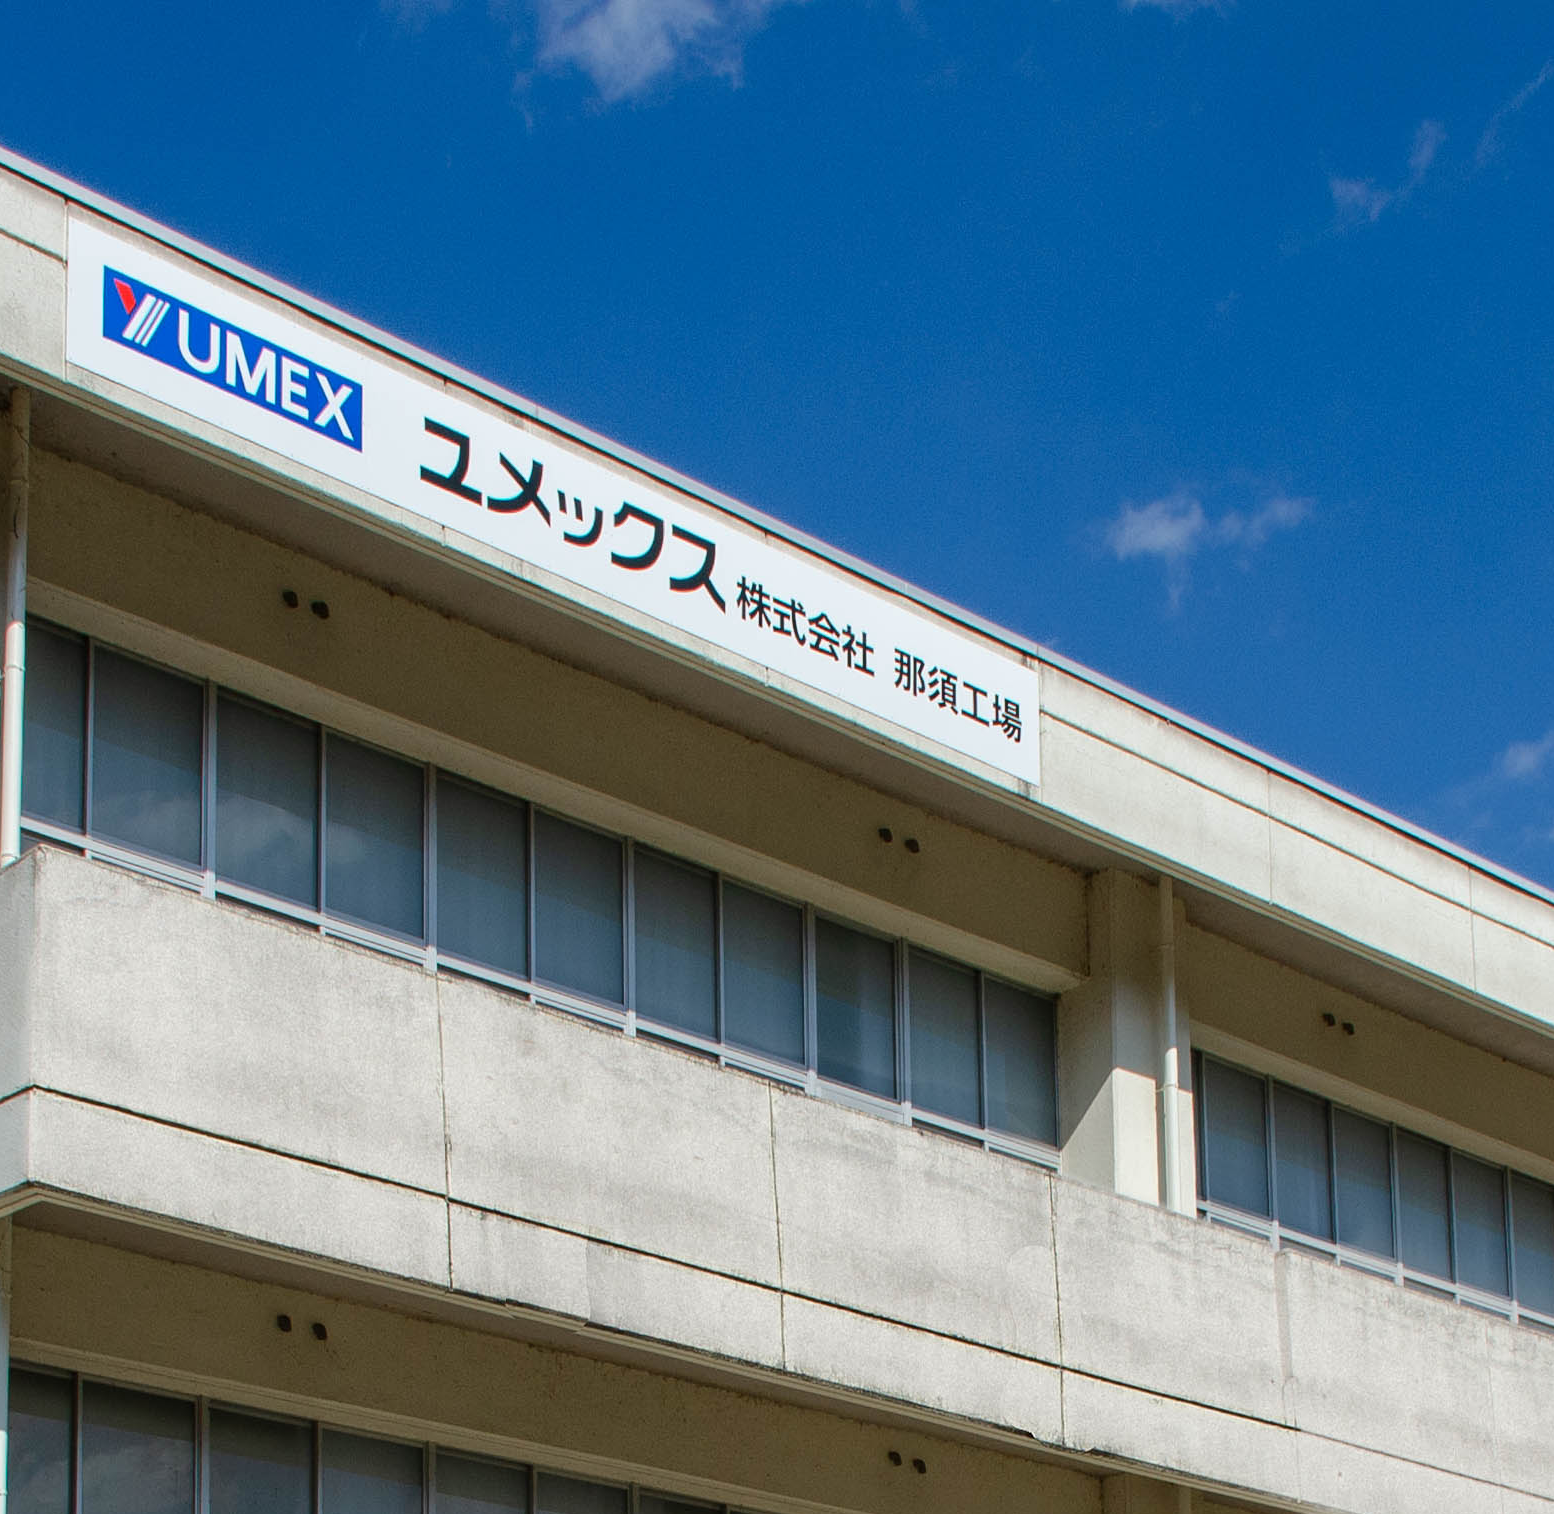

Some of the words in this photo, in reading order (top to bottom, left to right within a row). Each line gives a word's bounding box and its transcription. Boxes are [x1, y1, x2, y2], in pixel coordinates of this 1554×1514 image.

[113, 278, 355, 442] YUMEX
[420, 416, 726, 613] ユメックス
[735, 574, 876, 679] 株式会社
[893, 648, 1024, 745] 那須工場
